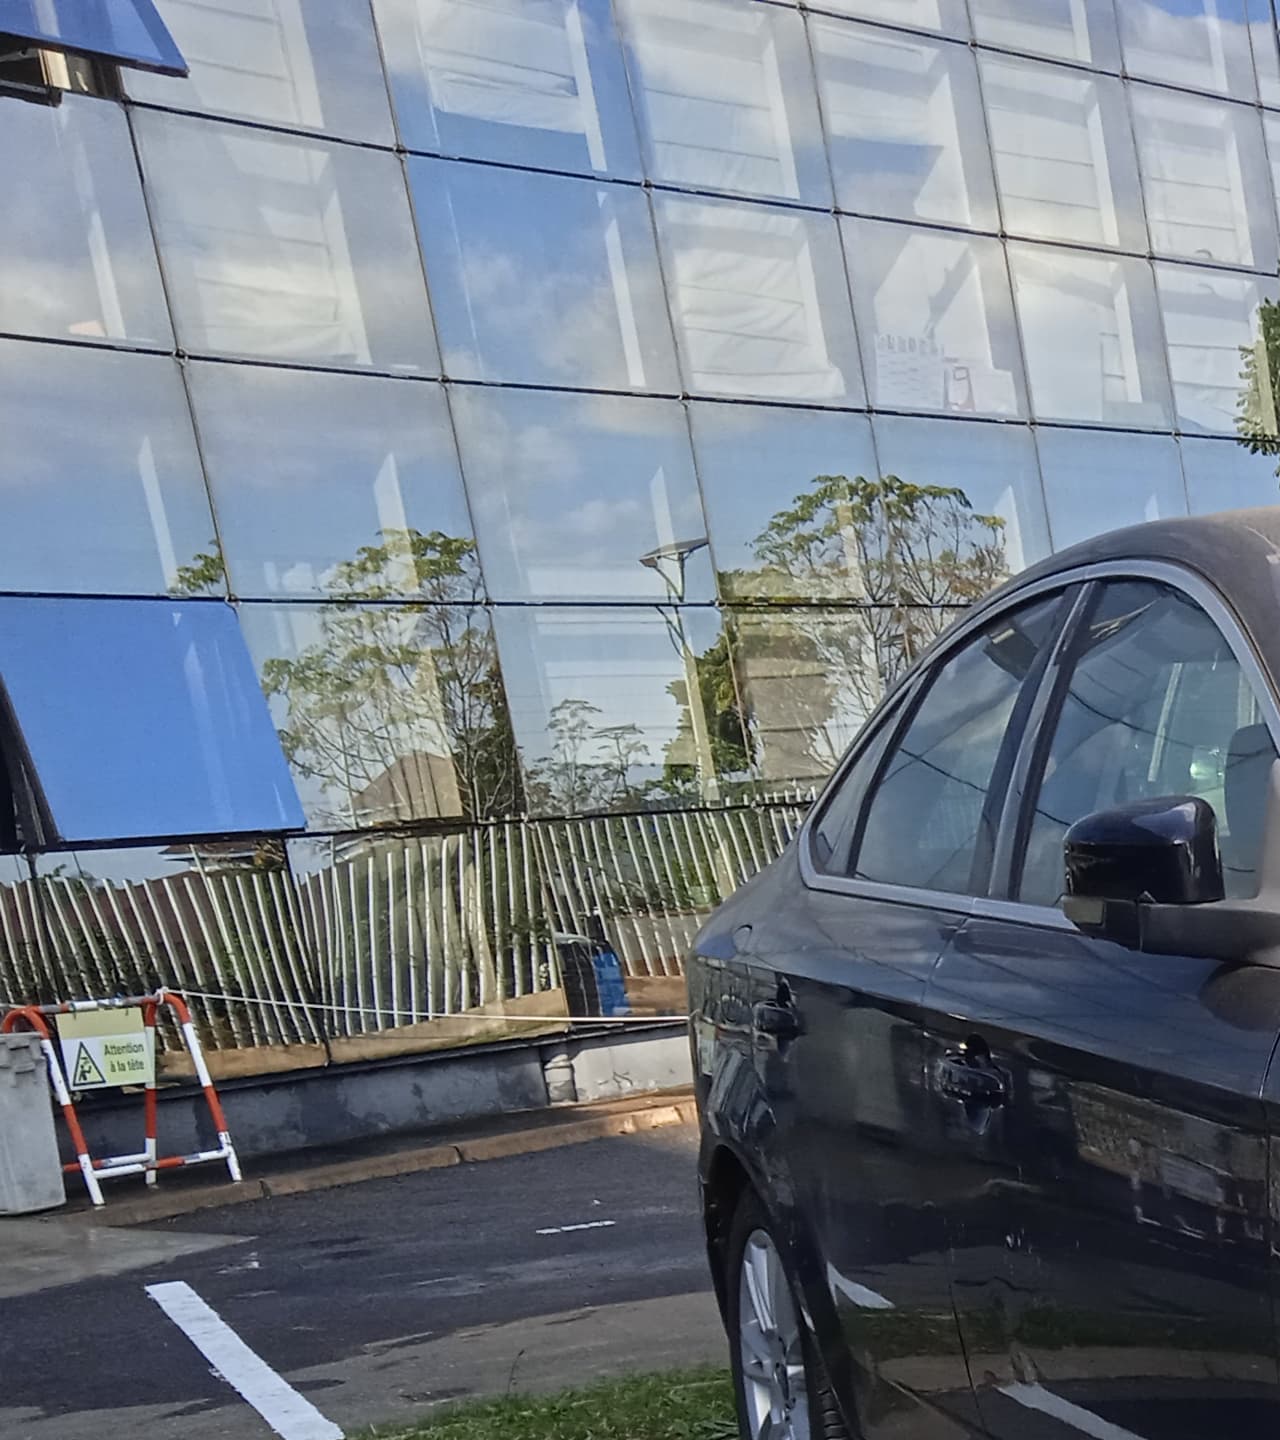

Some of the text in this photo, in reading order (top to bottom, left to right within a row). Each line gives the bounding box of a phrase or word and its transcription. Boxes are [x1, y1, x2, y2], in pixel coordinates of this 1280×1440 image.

[104, 1043, 145, 1056] Attention
[117, 1060, 126, 1072] la
[127, 1058, 145, 1071] tête
